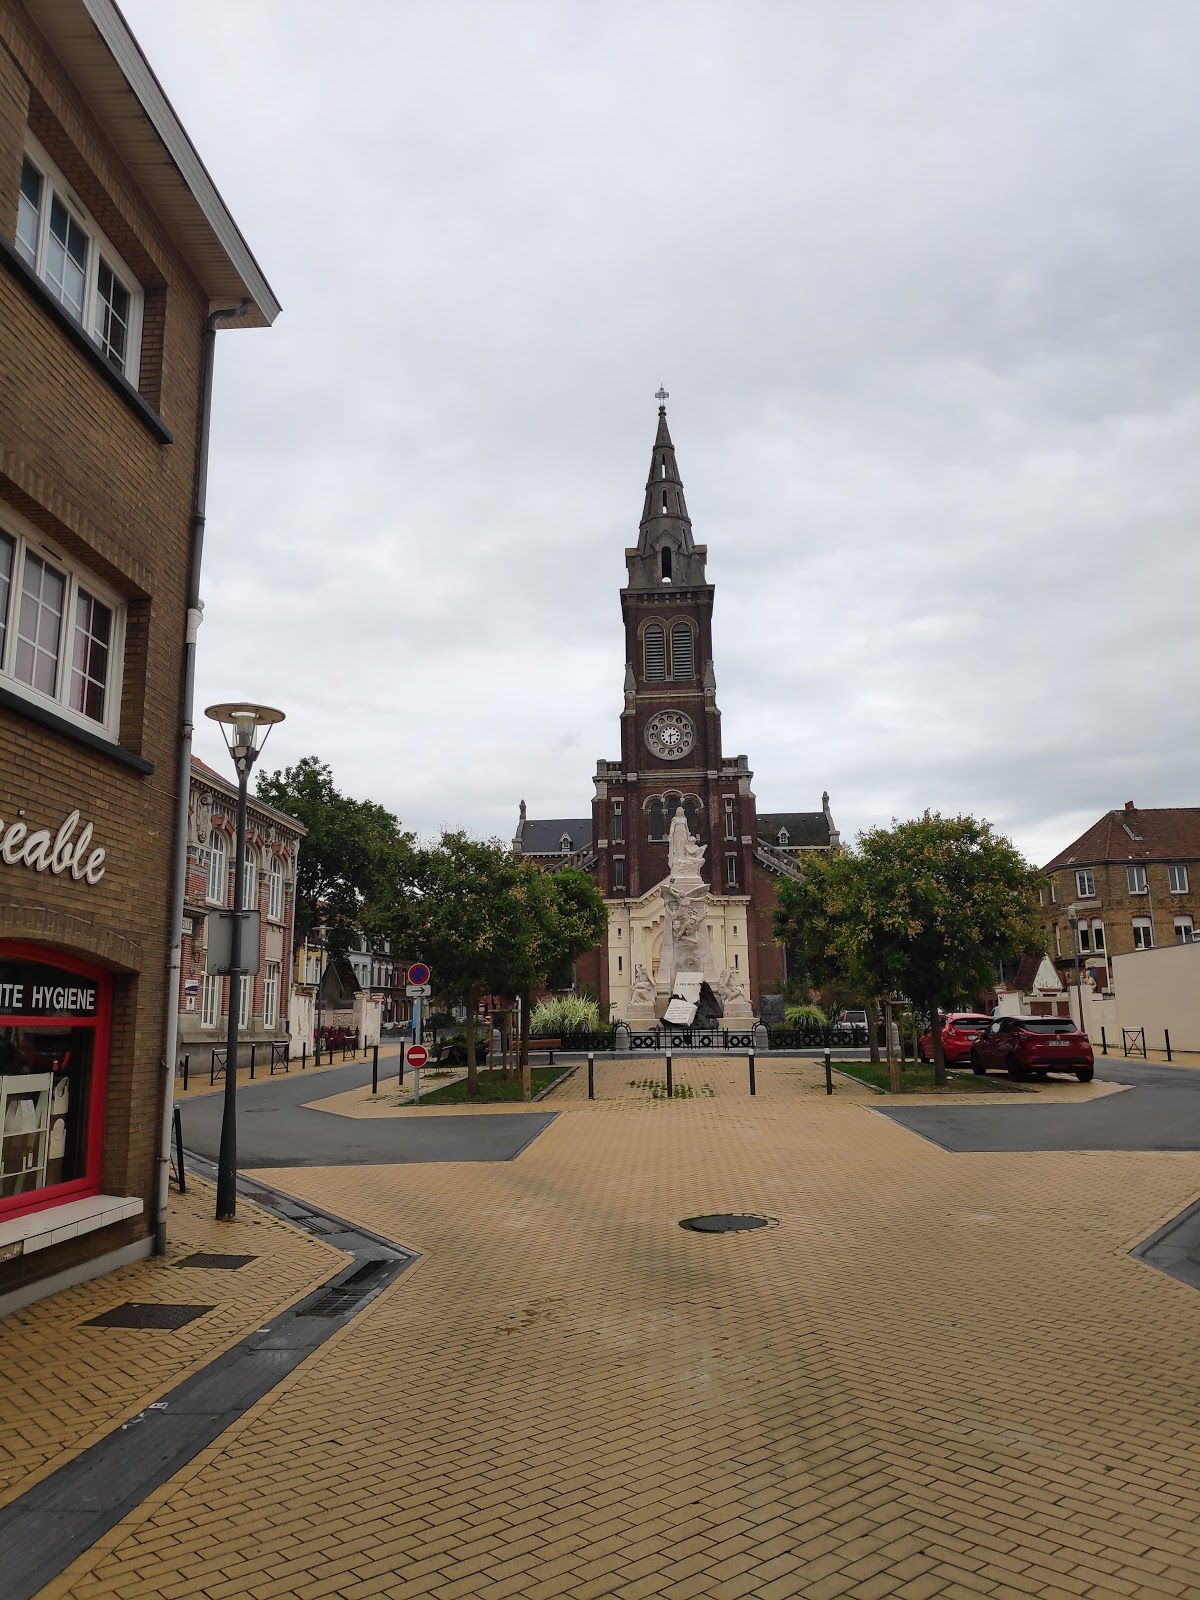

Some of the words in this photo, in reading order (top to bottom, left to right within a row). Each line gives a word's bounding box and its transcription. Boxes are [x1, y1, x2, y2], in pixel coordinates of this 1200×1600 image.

[0, 809, 106, 885] eable
[0, 983, 24, 1008] TE
[31, 985, 96, 1010] HYGIENE
